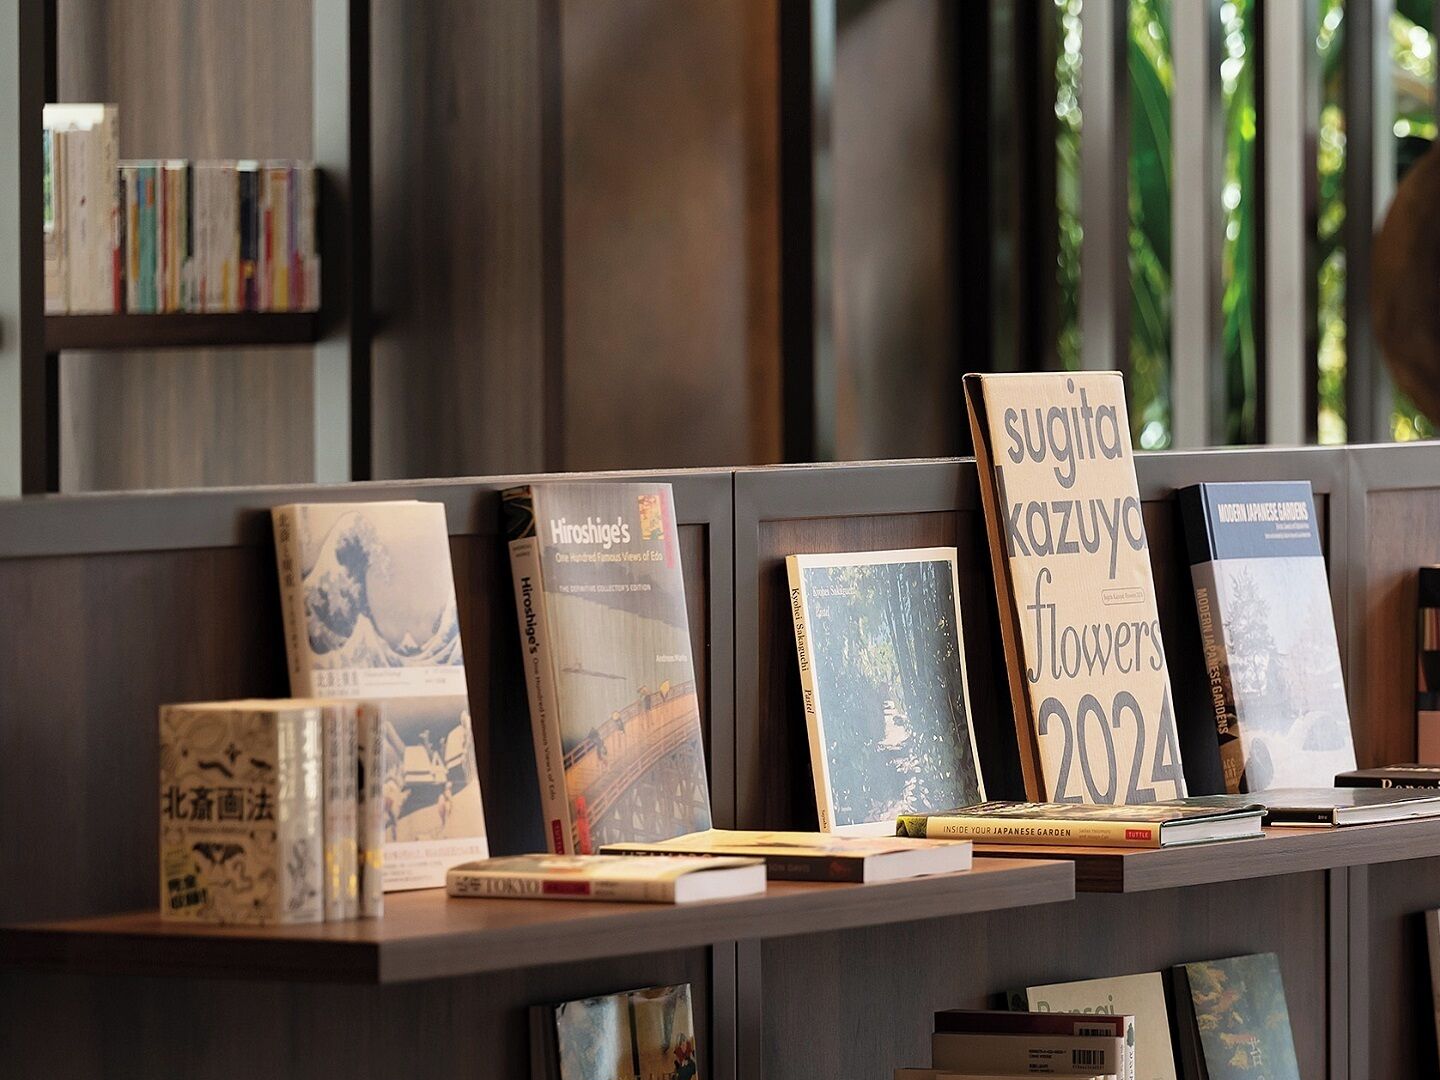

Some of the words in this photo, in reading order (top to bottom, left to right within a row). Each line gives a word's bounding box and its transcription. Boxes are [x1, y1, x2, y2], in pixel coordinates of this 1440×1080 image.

[1004, 378, 1122, 490] sugita
[550, 516, 631, 549] Hiroshige's
[996, 465, 1147, 580] kazuya
[1218, 503, 1246, 523] MODERN
[1246, 502, 1279, 522] JAPANESE
[1277, 501, 1308, 521] GARDENS
[520, 577, 538, 654] Hiroshige's
[792, 587, 802, 621] Kyohei
[1026, 567, 1165, 686] flowers
[1196, 588, 1210, 632] MODERN
[795, 622, 809, 673] Sakaguchi
[1202, 633, 1221, 683] JAPANESE
[804, 689, 815, 715] Pastel
[1213, 684, 1228, 735] GARDENS
[1038, 681, 1188, 805] 2024
[161, 785, 275, 822] 北斎画法
[943, 825, 969, 834] INSIDE
[971, 826, 992, 834] YOUR
[993, 826, 1035, 836] JAPANESE
[1037, 828, 1071, 837] GARDEN
[1127, 831, 1150, 839] TUTTLE
